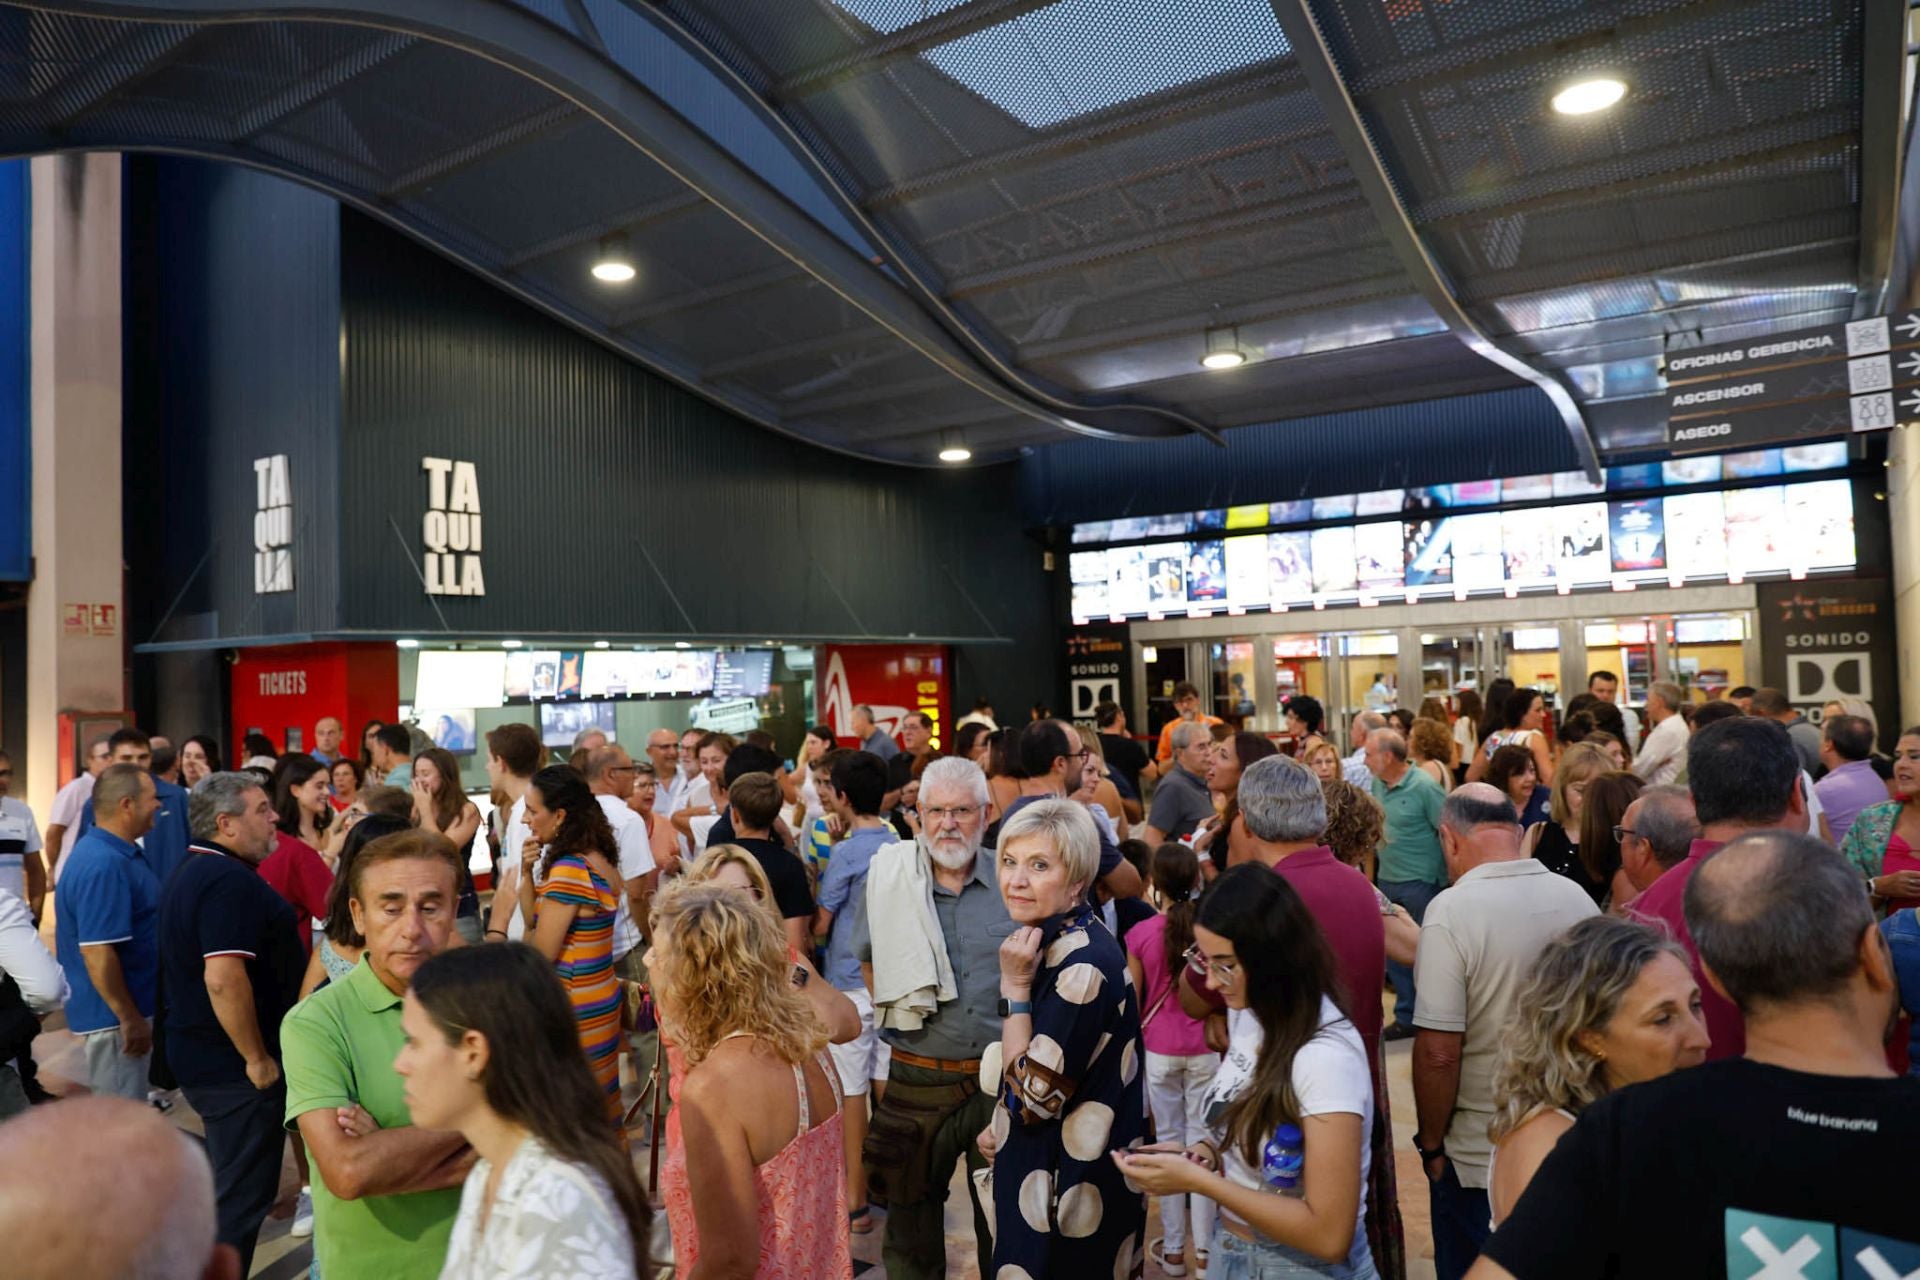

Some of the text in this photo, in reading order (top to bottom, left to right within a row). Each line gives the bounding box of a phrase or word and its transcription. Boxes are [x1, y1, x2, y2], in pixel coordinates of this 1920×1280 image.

[1670, 335, 1833, 371] OFICINAS GERENCIA
[1672, 383, 1765, 406] ASCENSOR
[1674, 423, 1732, 441] ASEOS
[254, 454, 291, 510] TA
[422, 457, 481, 513] TA
[254, 506, 291, 552] QUI
[423, 510, 482, 553] QUI
[255, 550, 293, 593] LLA
[424, 552, 485, 596] LLA
[1786, 632, 1870, 647] SONIDO
[258, 670, 307, 696] TICKETS
[1071, 663, 1119, 675] SONIDO
[1787, 1105, 1878, 1131] blue banana
